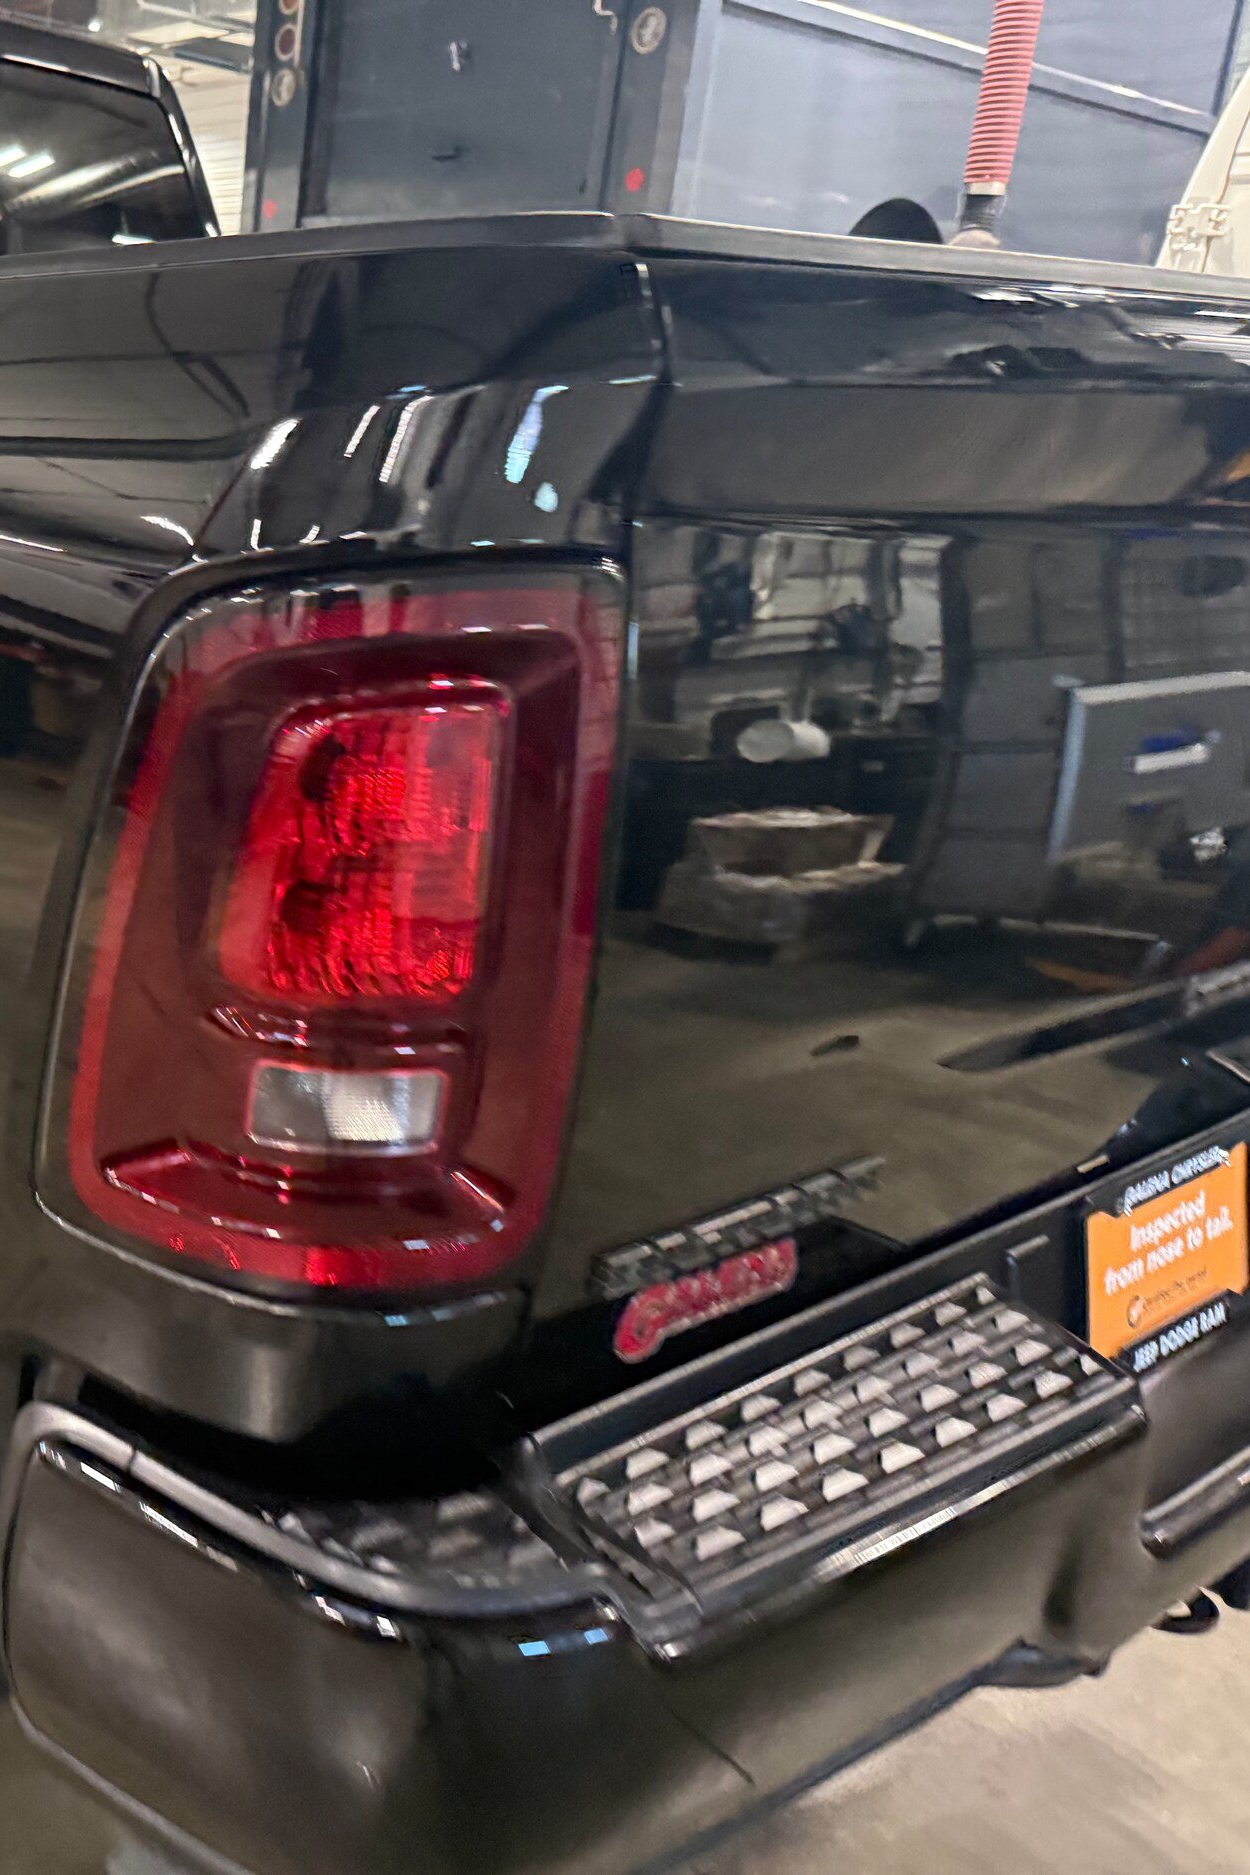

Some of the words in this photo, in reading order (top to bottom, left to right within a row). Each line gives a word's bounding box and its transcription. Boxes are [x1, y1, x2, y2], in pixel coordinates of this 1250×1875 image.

[1129, 1190, 1206, 1250] Inspected
[1104, 1260, 1146, 1296] from
[1146, 1236, 1184, 1269] nose
[1185, 1225, 1205, 1250] to
[1134, 1340, 1158, 1373] JEEP
[1159, 1317, 1200, 1358] DODGE
[1199, 1301, 1227, 1333] RAM
